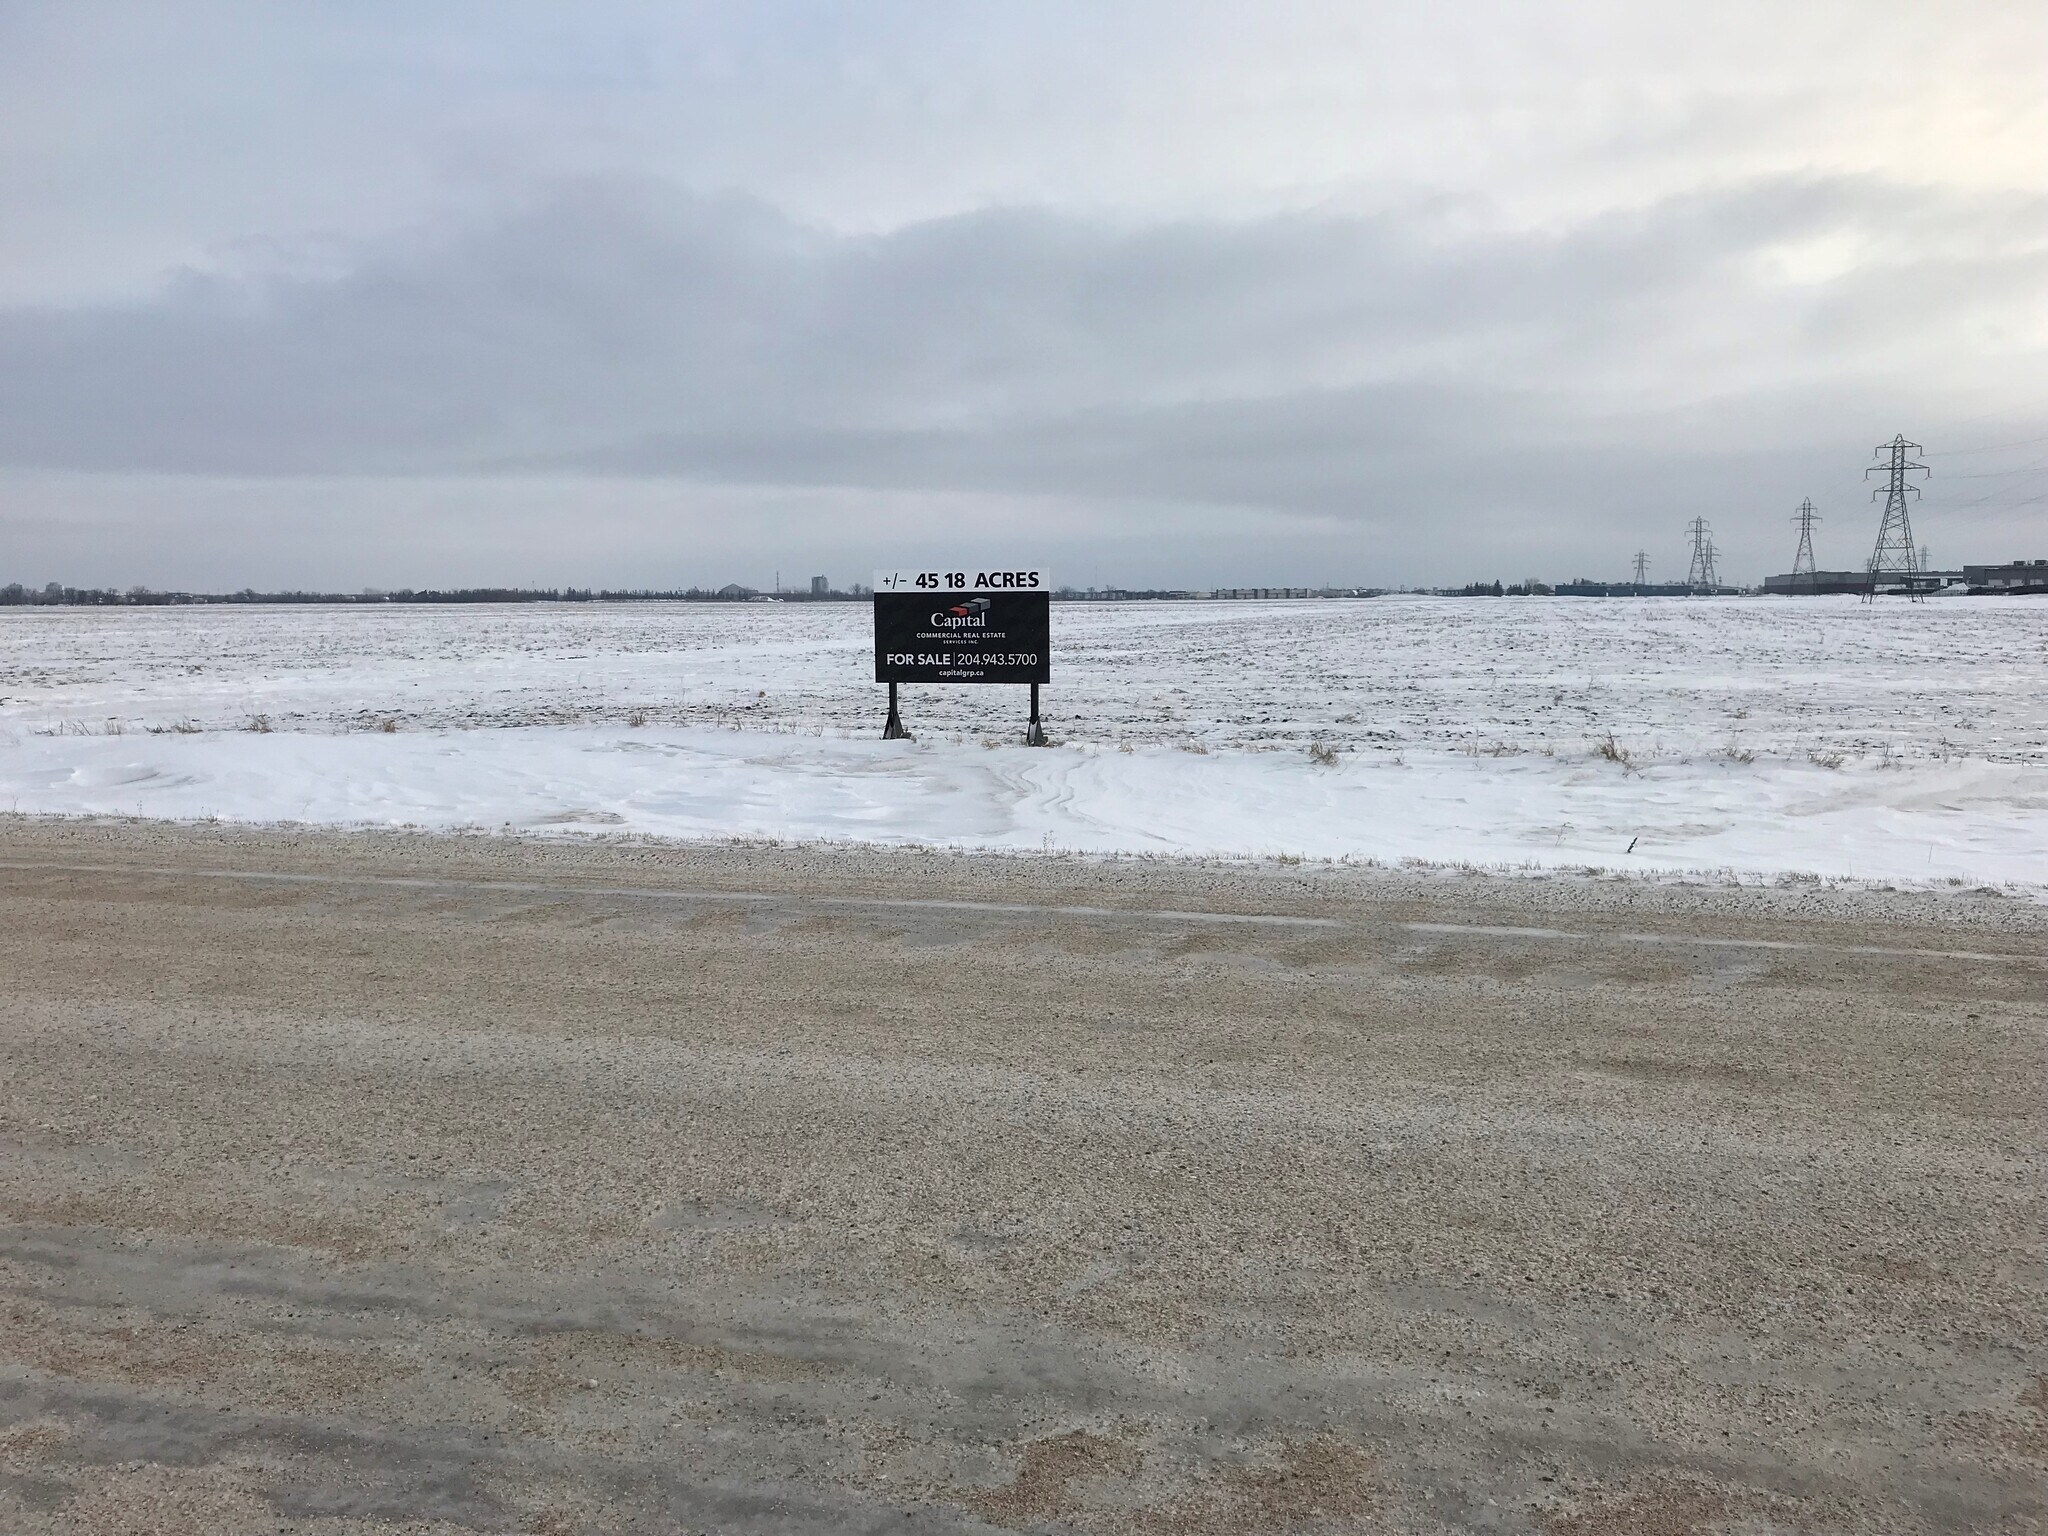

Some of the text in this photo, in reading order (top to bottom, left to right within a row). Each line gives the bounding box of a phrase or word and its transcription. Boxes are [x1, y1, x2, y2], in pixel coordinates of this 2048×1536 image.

[974, 571, 1040, 588] ACRES
[930, 611, 986, 630] Capital
[886, 653, 1038, 666] FOR SALE 204.943.5700
[938, 669, 984, 678] capitalgrp.ca
